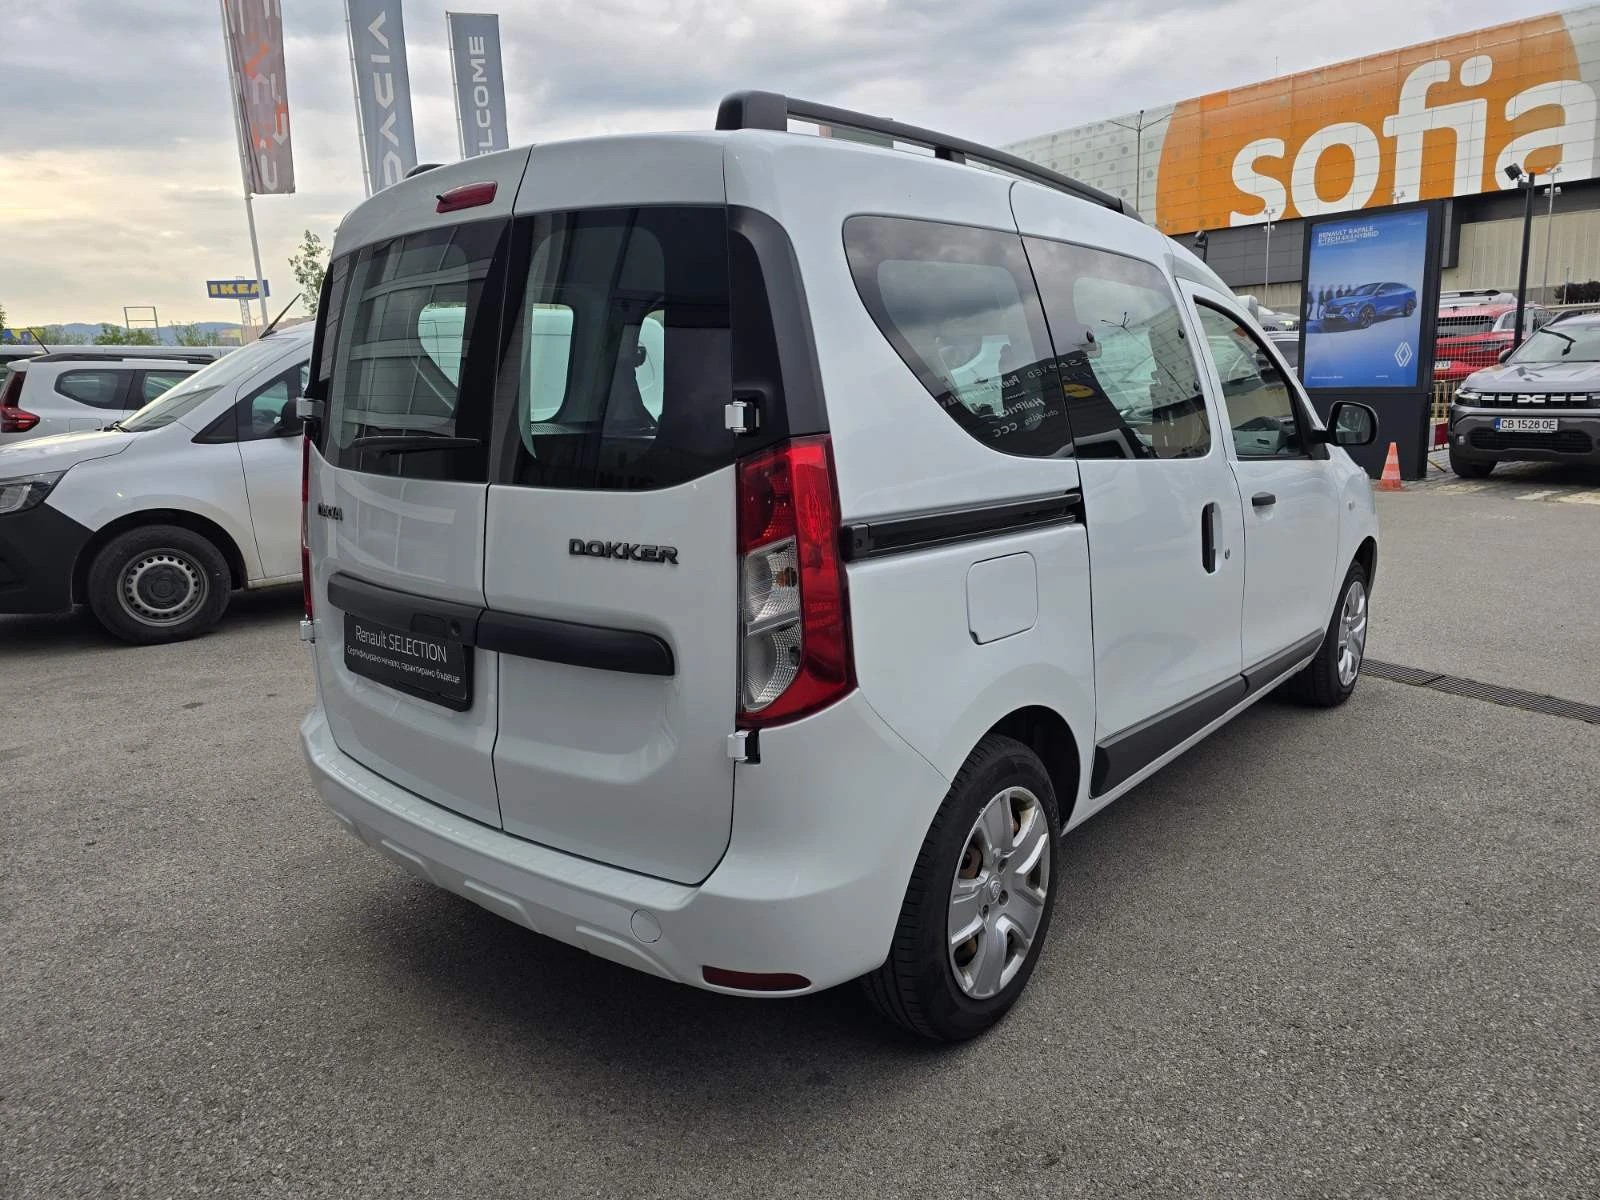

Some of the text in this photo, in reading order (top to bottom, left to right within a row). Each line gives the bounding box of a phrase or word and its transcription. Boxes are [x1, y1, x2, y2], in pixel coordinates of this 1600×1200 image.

[367, 10, 401, 187] DACIA
[469, 36, 493, 155] LCOME
[1230, 54, 1599, 227] sofia
[1518, 420, 1540, 429] 1528
[569, 538, 680, 565] DOKKER
[355, 625, 447, 663] Renault SELECTION
